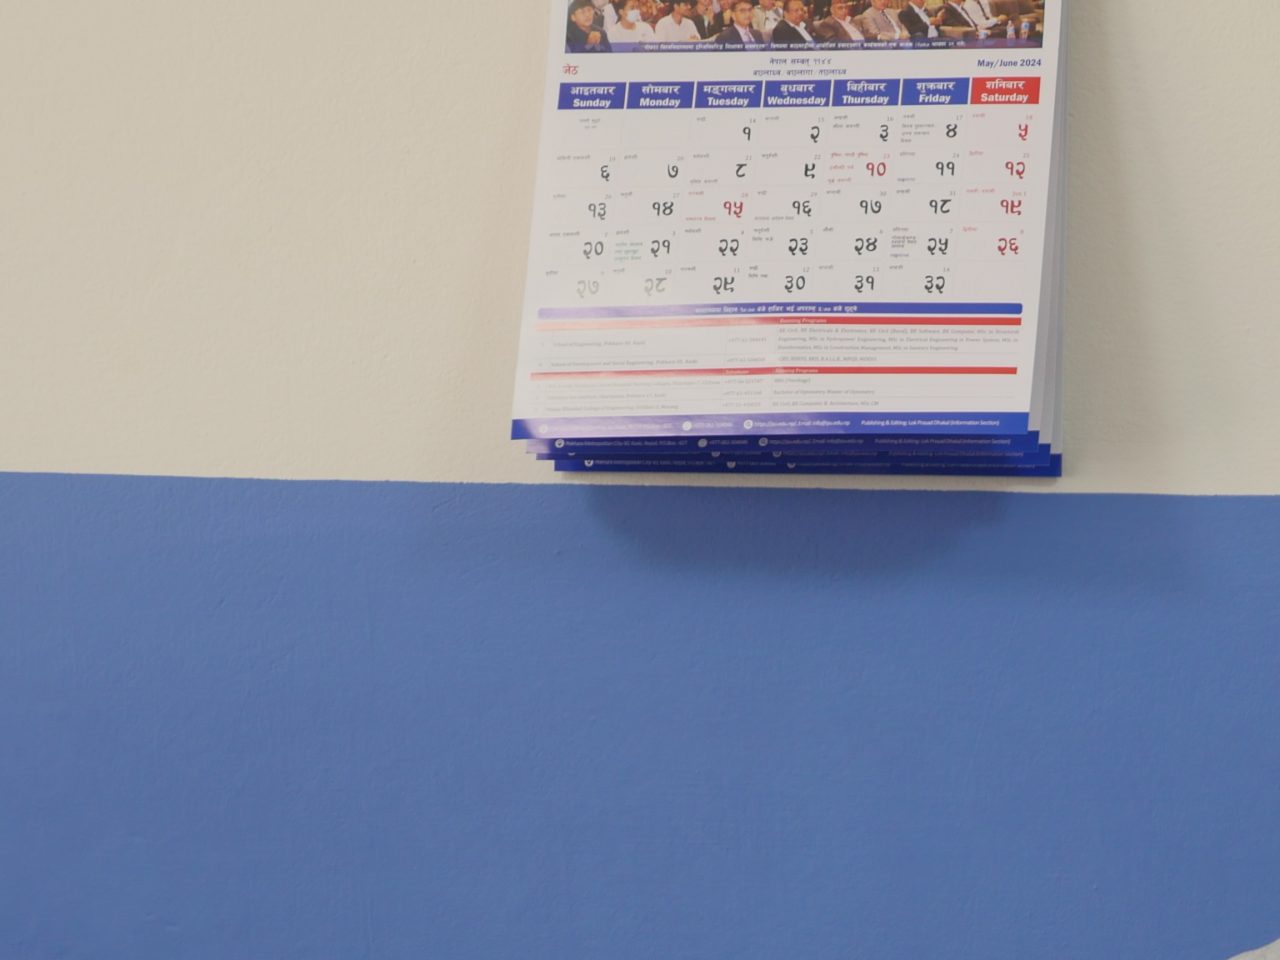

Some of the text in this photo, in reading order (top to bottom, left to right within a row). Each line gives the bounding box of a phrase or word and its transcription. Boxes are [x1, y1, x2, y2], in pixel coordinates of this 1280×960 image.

[562, 63, 579, 76] जेठ
[977, 58, 1042, 69] May/June 2024
[570, 86, 616, 96] आइतबार
[641, 84, 681, 95] सोमबार
[779, 83, 816, 95] बुधबार
[985, 79, 1025, 90] शनिबार
[573, 98, 611, 109] Sunday
[639, 97, 681, 109] Monday
[707, 97, 750, 108] Tuesday
[767, 96, 827, 107] Wednesday
[842, 95, 890, 106] Thursday
[919, 94, 952, 105] Friday
[980, 93, 1029, 104] Saturday
[742, 126, 752, 141] १
[810, 125, 820, 144] २
[879, 124, 889, 142] ३
[945, 123, 958, 139] ४
[1018, 124, 1029, 142] ५
[600, 165, 611, 182] ६
[667, 163, 679, 178] ७
[735, 163, 748, 178] ८
[804, 162, 816, 179] ९
[865, 161, 887, 177] १०
[935, 161, 956, 176] ११
[1005, 161, 1026, 180] १२
[588, 202, 607, 220] १३
[652, 201, 674, 217] १४
[723, 201, 744, 219] १५
[791, 200, 812, 217] १६
[859, 199, 882, 215] १७
[929, 198, 952, 214] १८
[999, 199, 1022, 216] १९
[583, 241, 604, 260] २०
[650, 239, 671, 258] २१
[718, 238, 740, 257] २२
[788, 237, 809, 256] २३
[854, 237, 878, 256] २४
[927, 237, 949, 256] २५
[997, 237, 1019, 256] २६
[576, 279, 600, 298] २७
[644, 277, 668, 296] २८
[712, 276, 735, 295] २९
[784, 275, 806, 294] ३०
[854, 275, 875, 294] ३१
[924, 275, 946, 294] ३२
